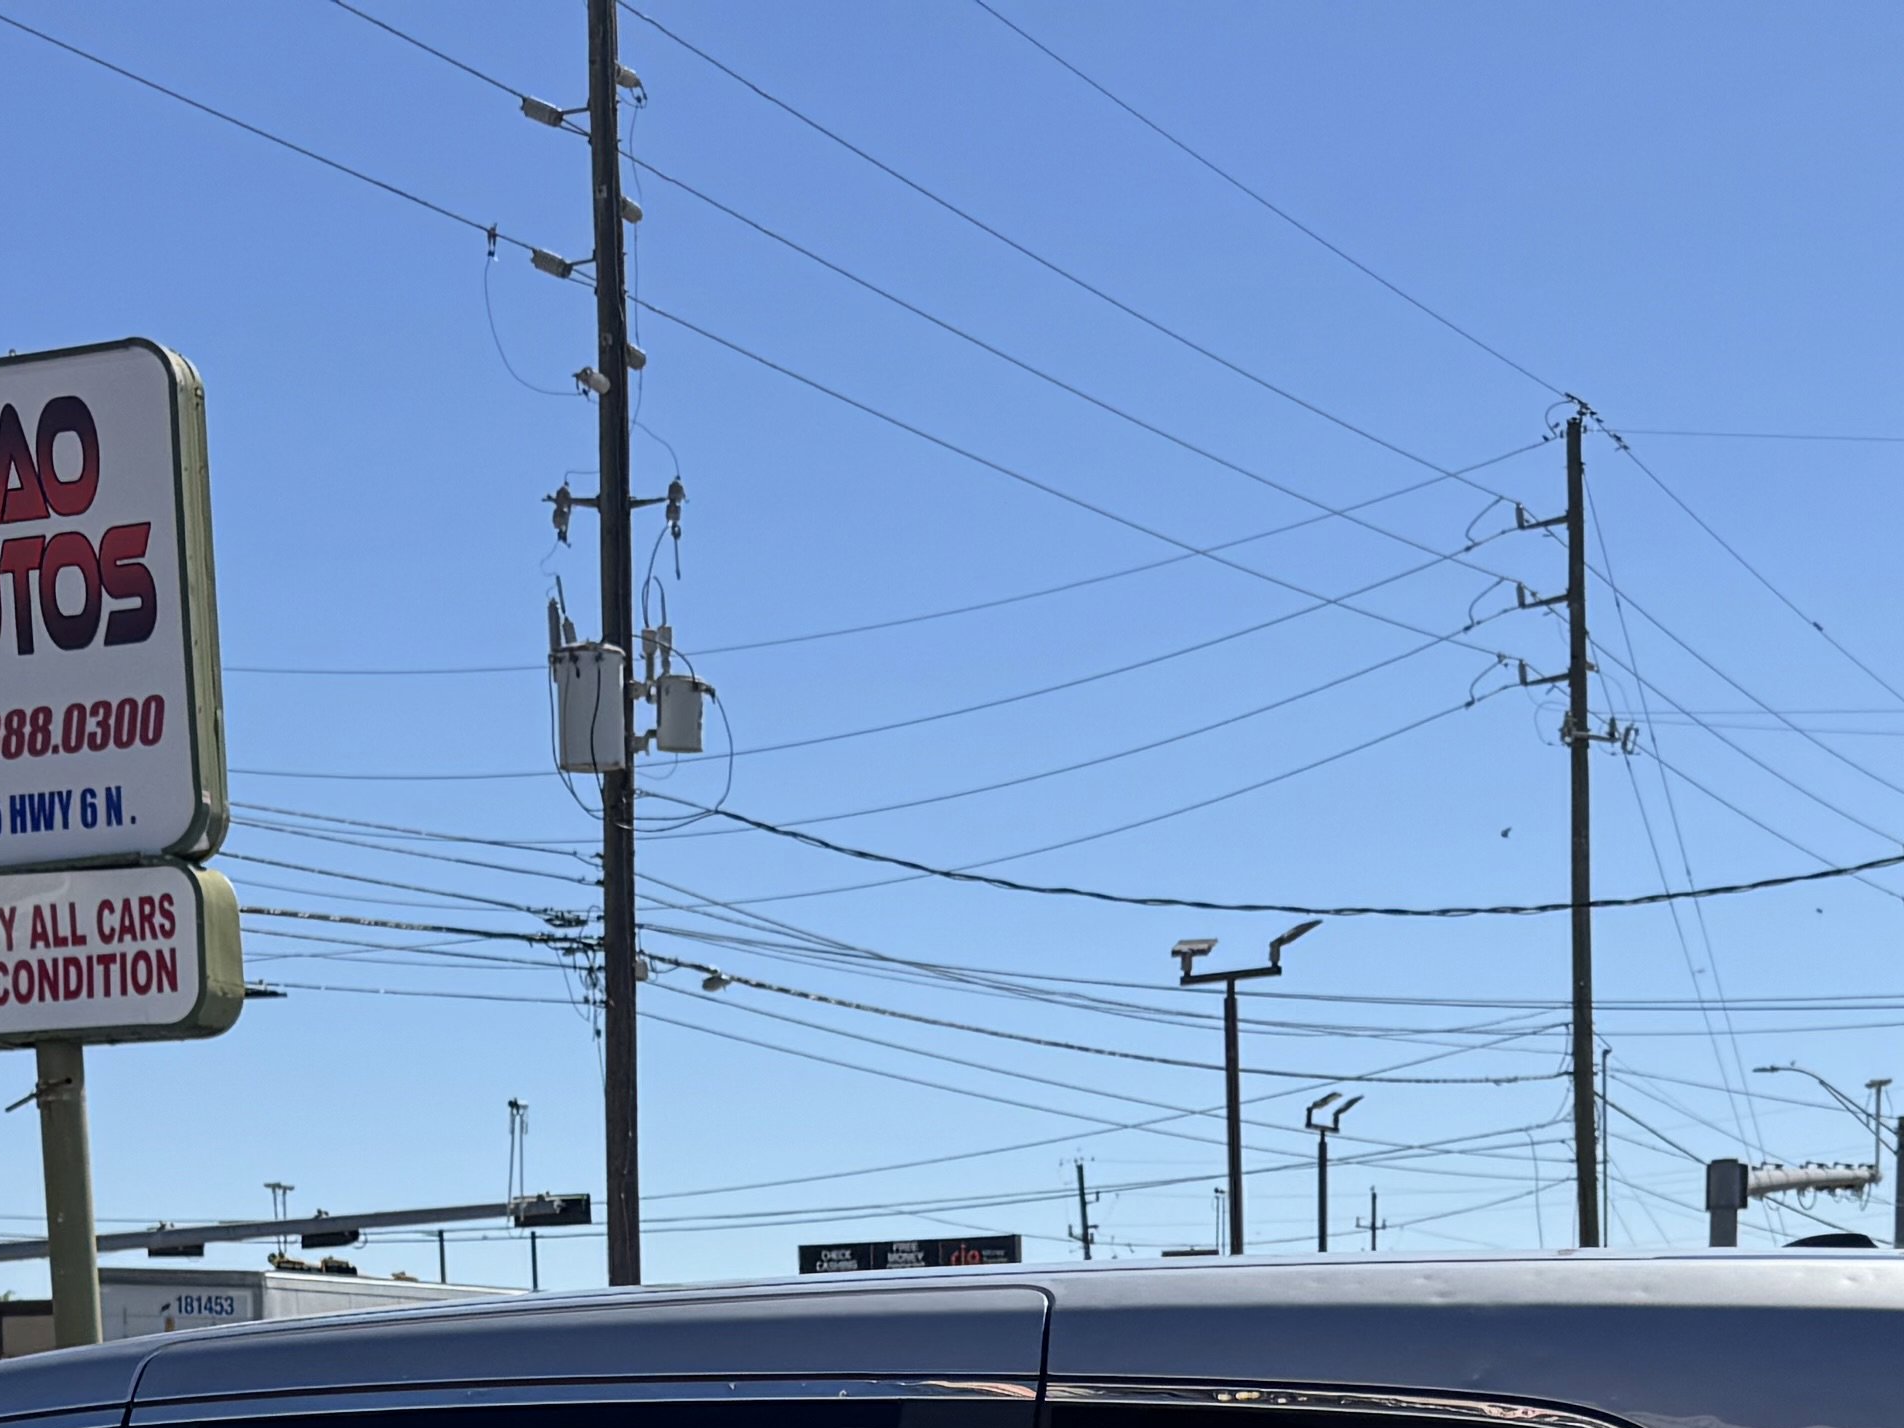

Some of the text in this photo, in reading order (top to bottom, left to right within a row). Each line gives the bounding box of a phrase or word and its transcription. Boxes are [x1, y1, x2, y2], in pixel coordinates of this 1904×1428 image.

[8, 789, 74, 836] HWY
[80, 787, 98, 830] 6
[30, 899, 87, 949] ALL
[97, 893, 177, 944] CARS
[176, 1295, 235, 1316] 181453
